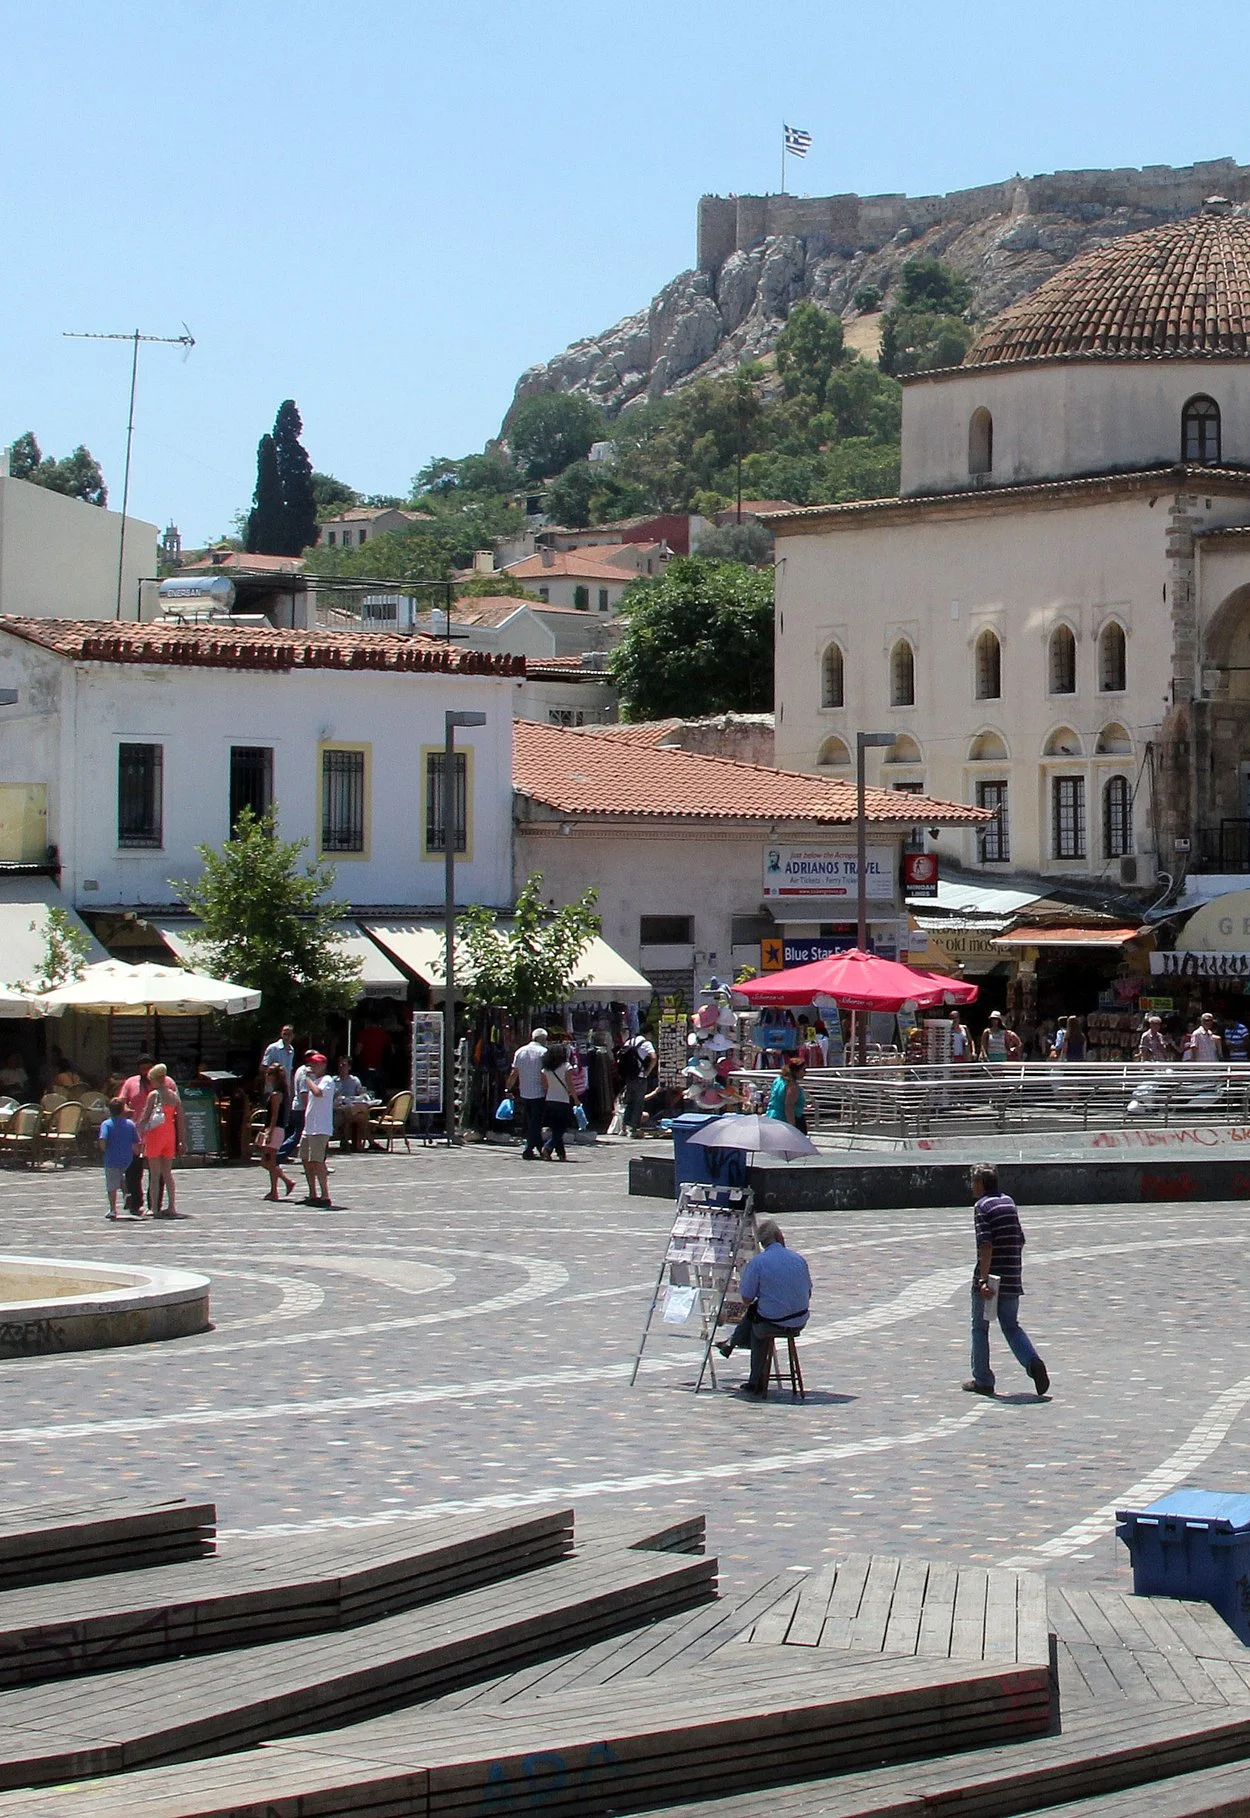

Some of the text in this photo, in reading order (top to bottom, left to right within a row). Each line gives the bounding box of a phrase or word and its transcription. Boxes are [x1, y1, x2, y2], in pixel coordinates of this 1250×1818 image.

[785, 862, 839, 874] ADRIANOS
[946, 938, 966, 951] old
[785, 947, 808, 961] Blue
[811, 946, 832, 961] Star
